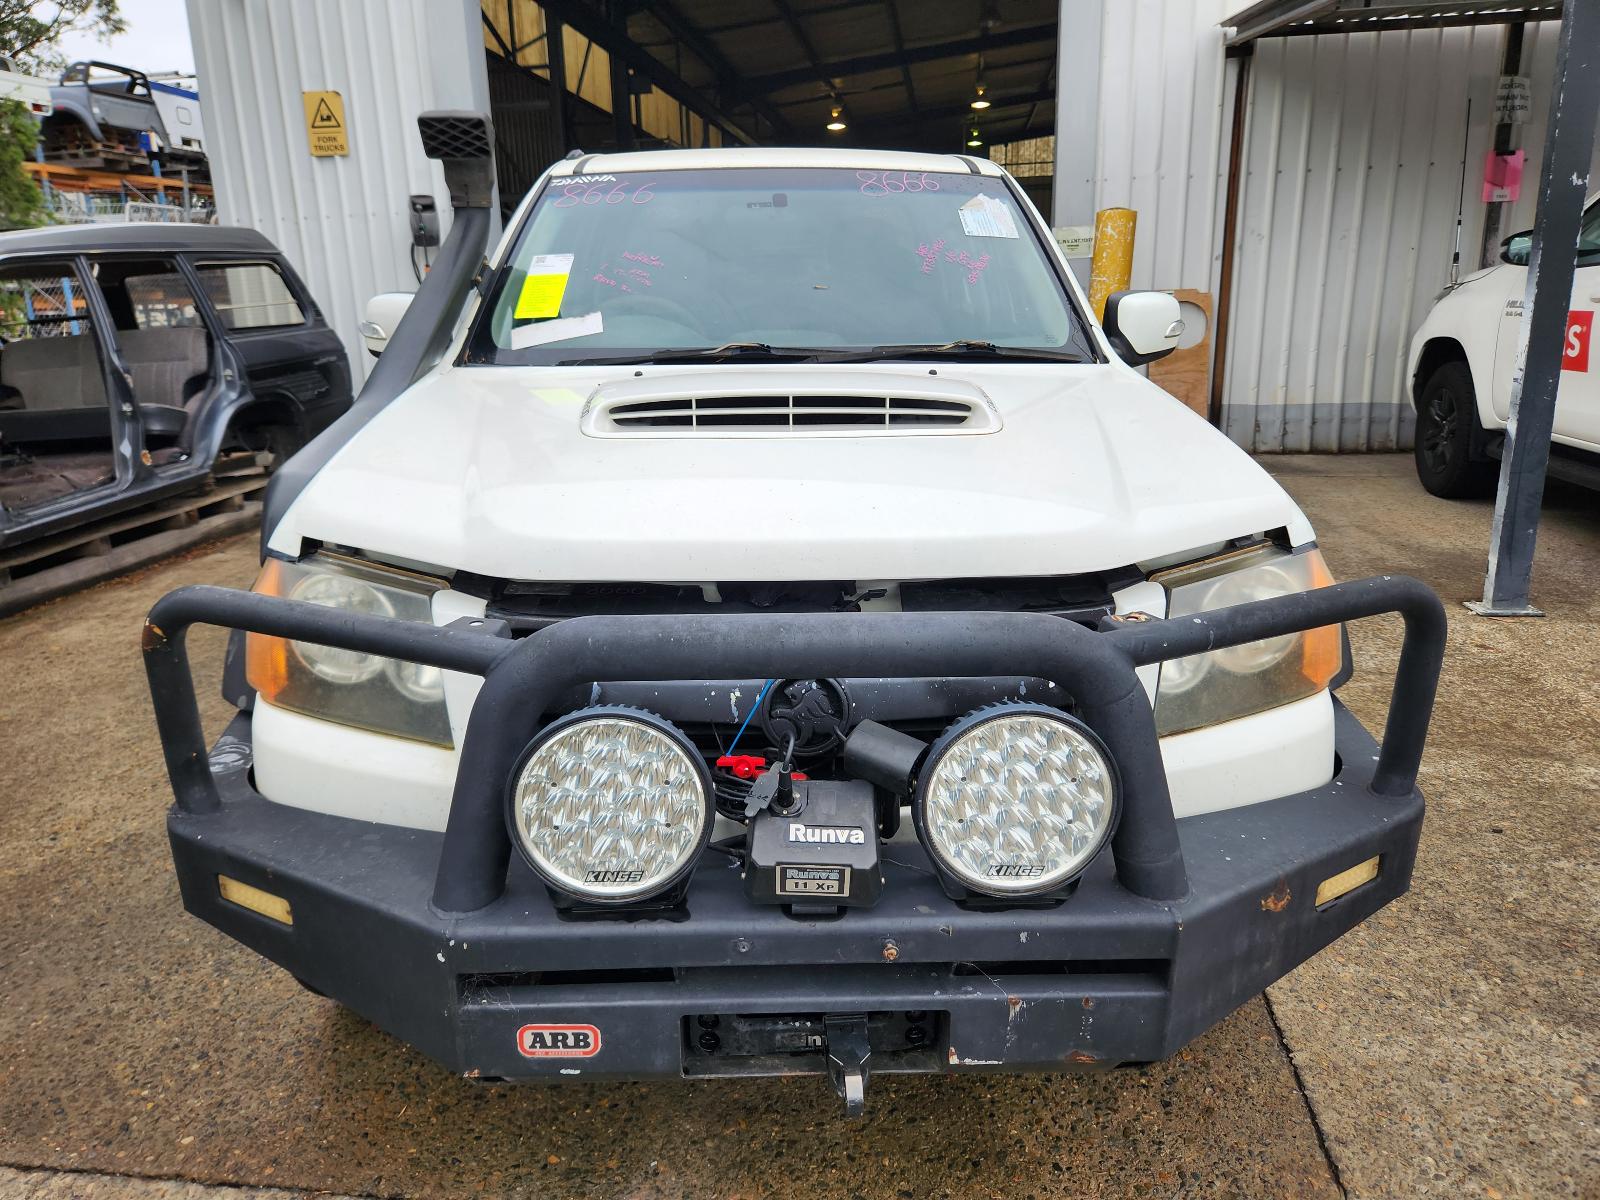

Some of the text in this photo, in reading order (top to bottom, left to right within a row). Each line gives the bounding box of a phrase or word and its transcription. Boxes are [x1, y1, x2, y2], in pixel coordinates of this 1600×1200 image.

[317, 136, 338, 144] FORK
[313, 144, 345, 152] TRUCKS
[856, 170, 940, 197] 8666
[553, 182, 657, 209] 8666
[788, 823, 865, 845] Runva
[585, 870, 644, 883] KINGS
[786, 868, 840, 880] Runva
[987, 865, 1045, 877] KINGS
[528, 1032, 591, 1049] ARB
